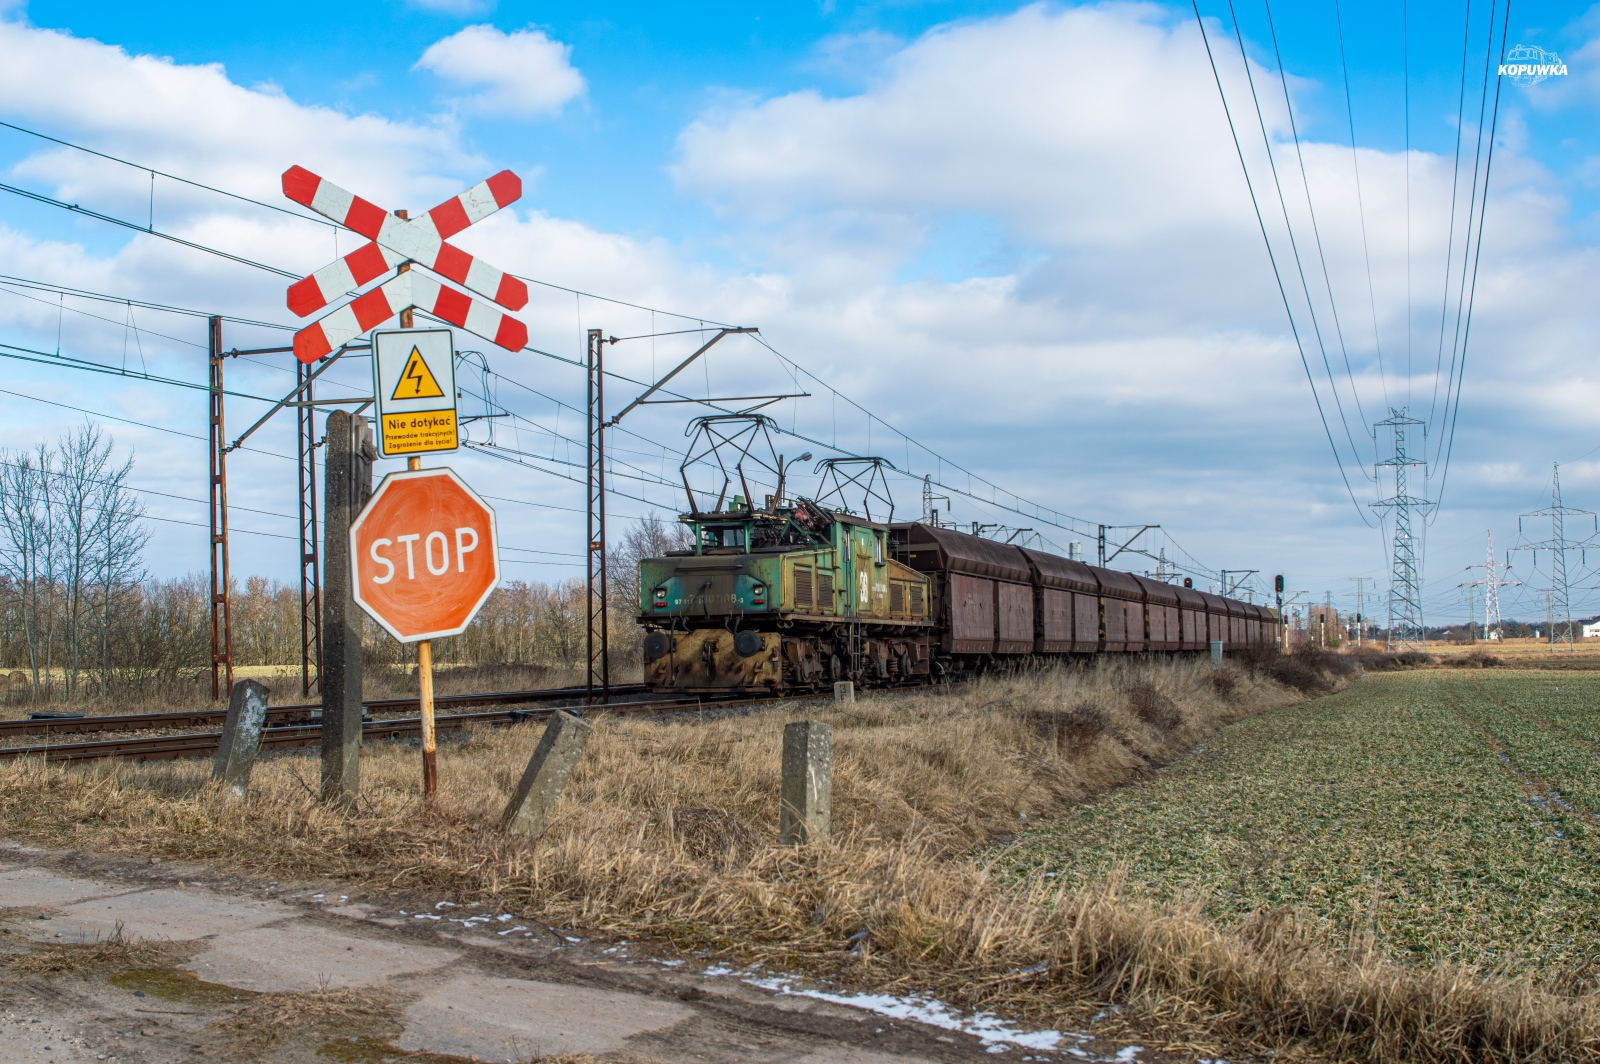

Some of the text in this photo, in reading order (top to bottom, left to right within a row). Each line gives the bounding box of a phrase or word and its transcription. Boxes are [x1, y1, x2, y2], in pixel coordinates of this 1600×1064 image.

[388, 415, 451, 430] Nie dotykać
[385, 429, 455, 440] Przewodów trakcyjnych!
[388, 441, 422, 450] Zagrożenie
[435, 438, 453, 447] życia!
[370, 526, 479, 585] STOP
